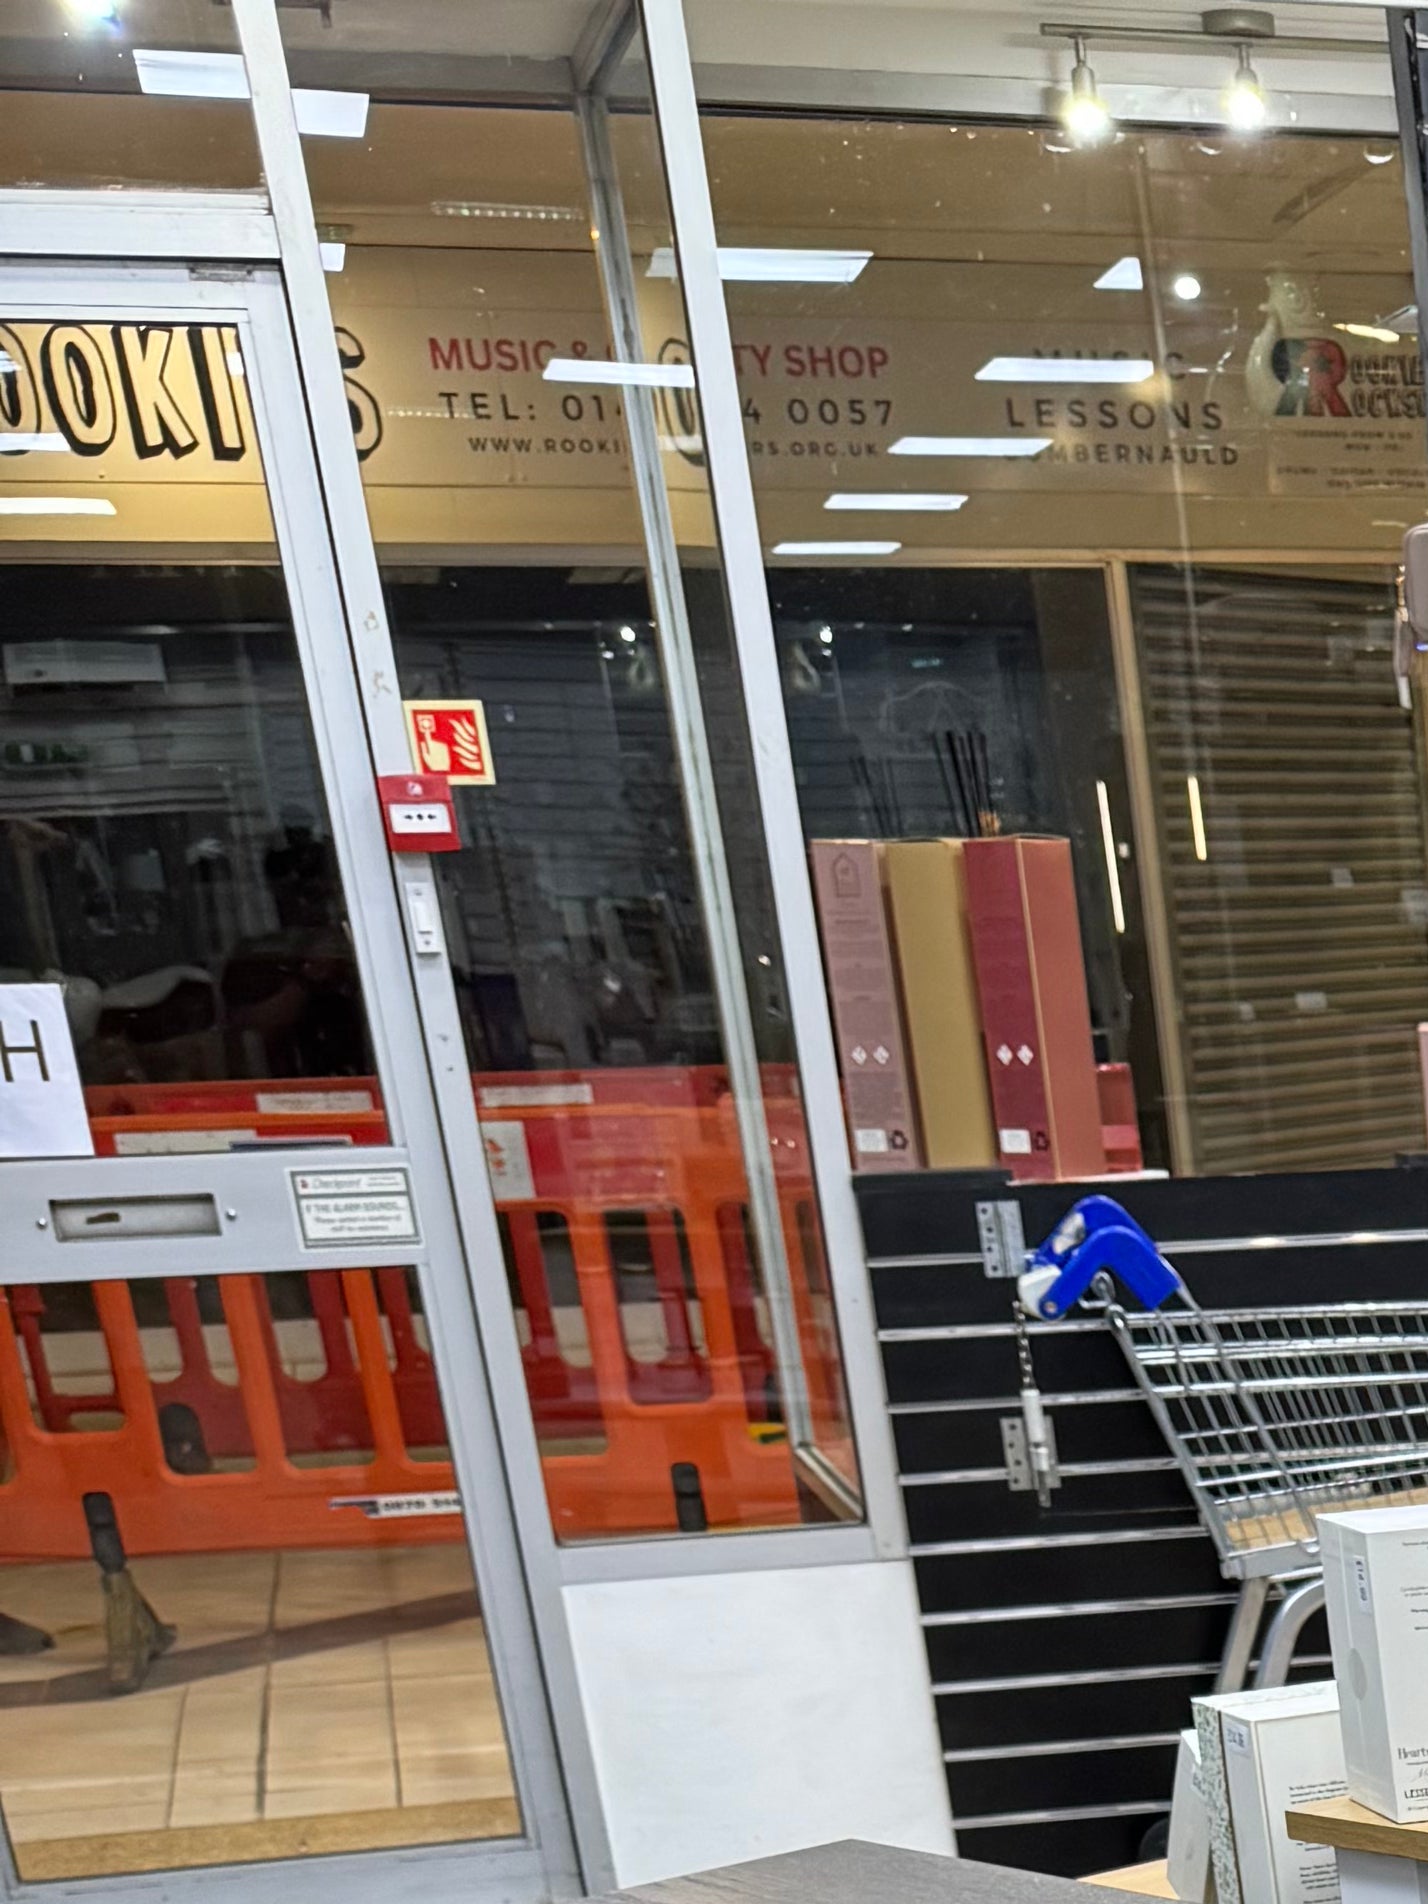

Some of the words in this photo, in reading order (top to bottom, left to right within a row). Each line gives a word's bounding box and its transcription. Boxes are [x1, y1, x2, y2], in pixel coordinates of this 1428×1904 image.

[785, 345, 889, 379] SHOP
[439, 391, 536, 421] TEL:
[787, 397, 894, 428] 0057
[1005, 397, 1223, 430] LESSONS
[0, 1020, 50, 1082] H
